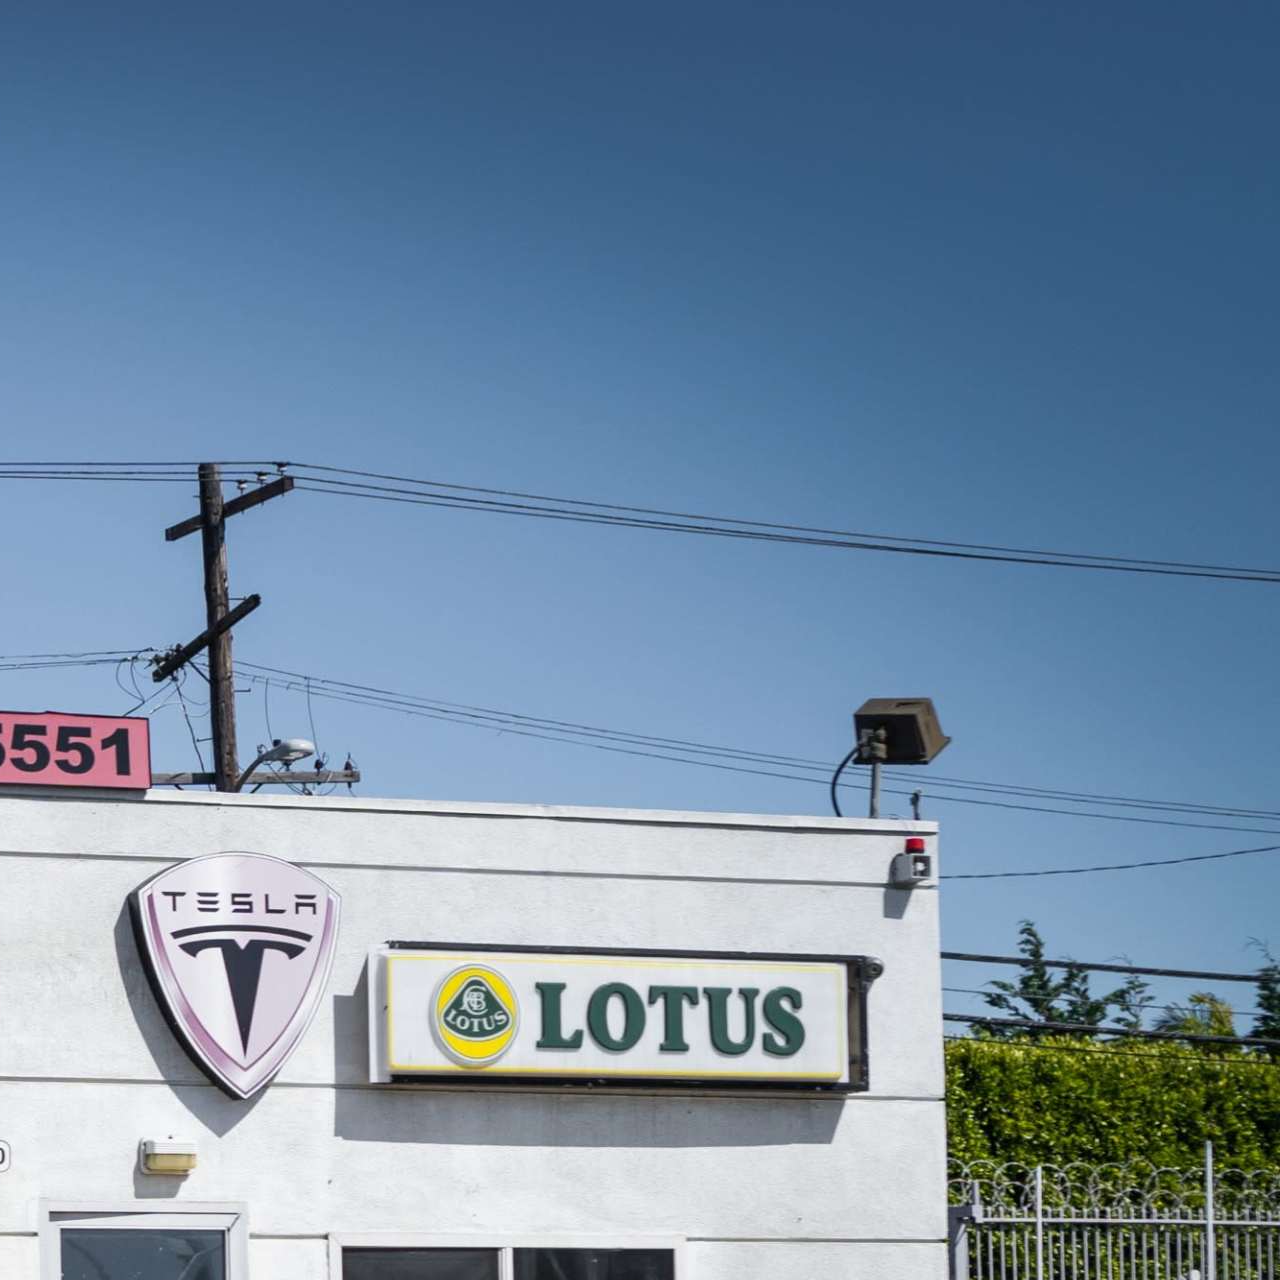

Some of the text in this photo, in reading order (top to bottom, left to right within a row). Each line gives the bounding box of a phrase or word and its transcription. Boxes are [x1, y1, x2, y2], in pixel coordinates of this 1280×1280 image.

[161, 891, 317, 915] TESLA
[446, 1008, 508, 1032] LOTUS
[535, 981, 806, 1057] LOTUS
